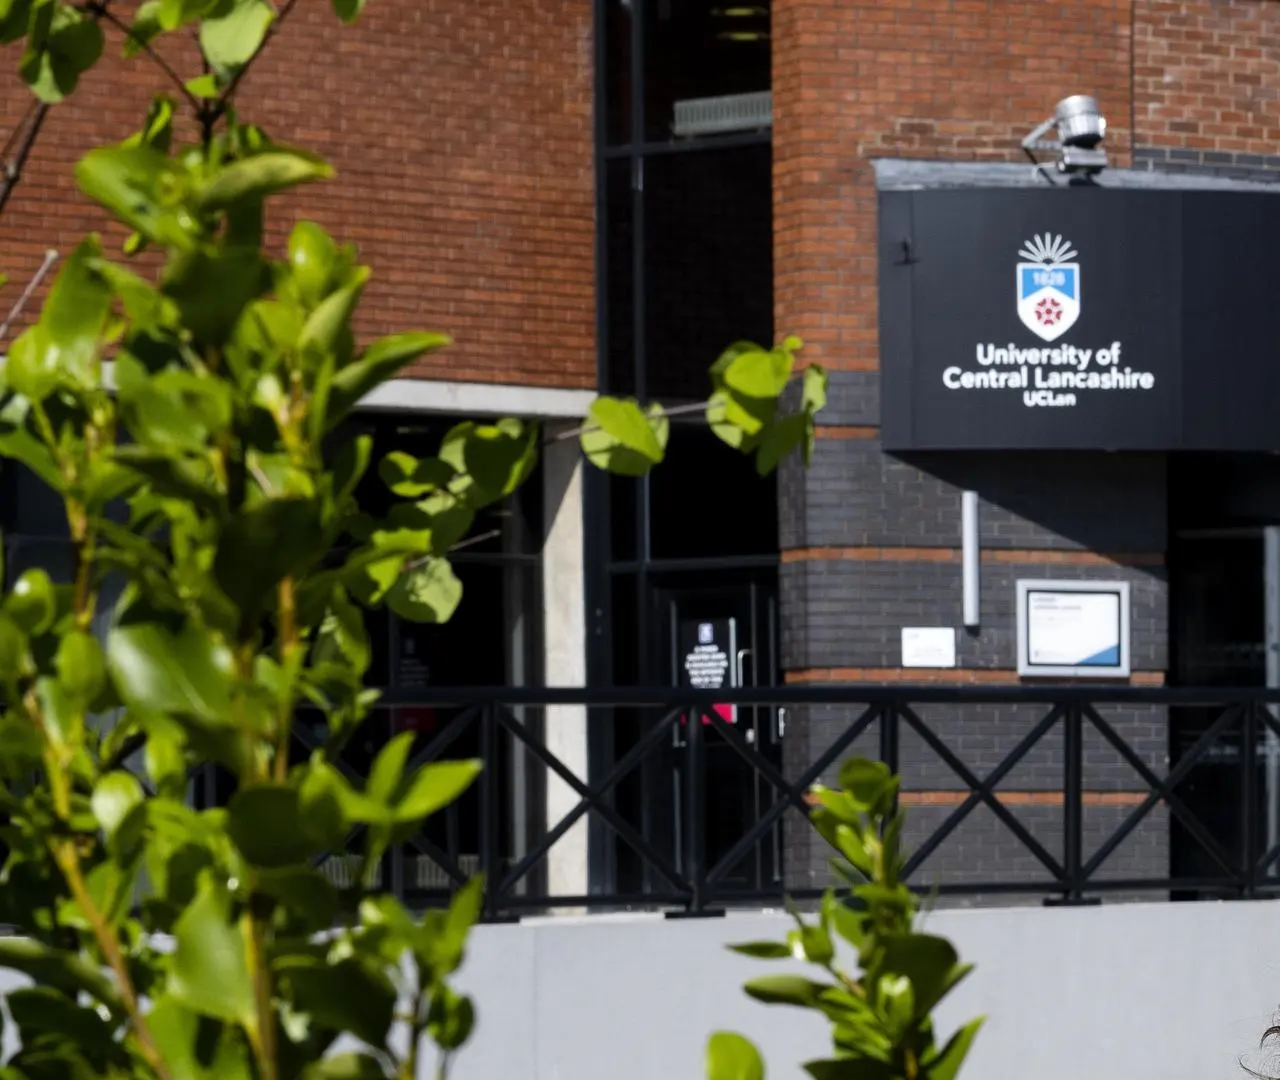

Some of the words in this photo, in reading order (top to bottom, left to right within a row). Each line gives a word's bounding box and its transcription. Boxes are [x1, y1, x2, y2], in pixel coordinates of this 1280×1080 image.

[976, 342, 1092, 370] University
[1095, 341, 1121, 365] of
[942, 365, 1028, 389] Central
[1035, 366, 1155, 390] Lancashire
[1023, 390, 1076, 407] UCLan
